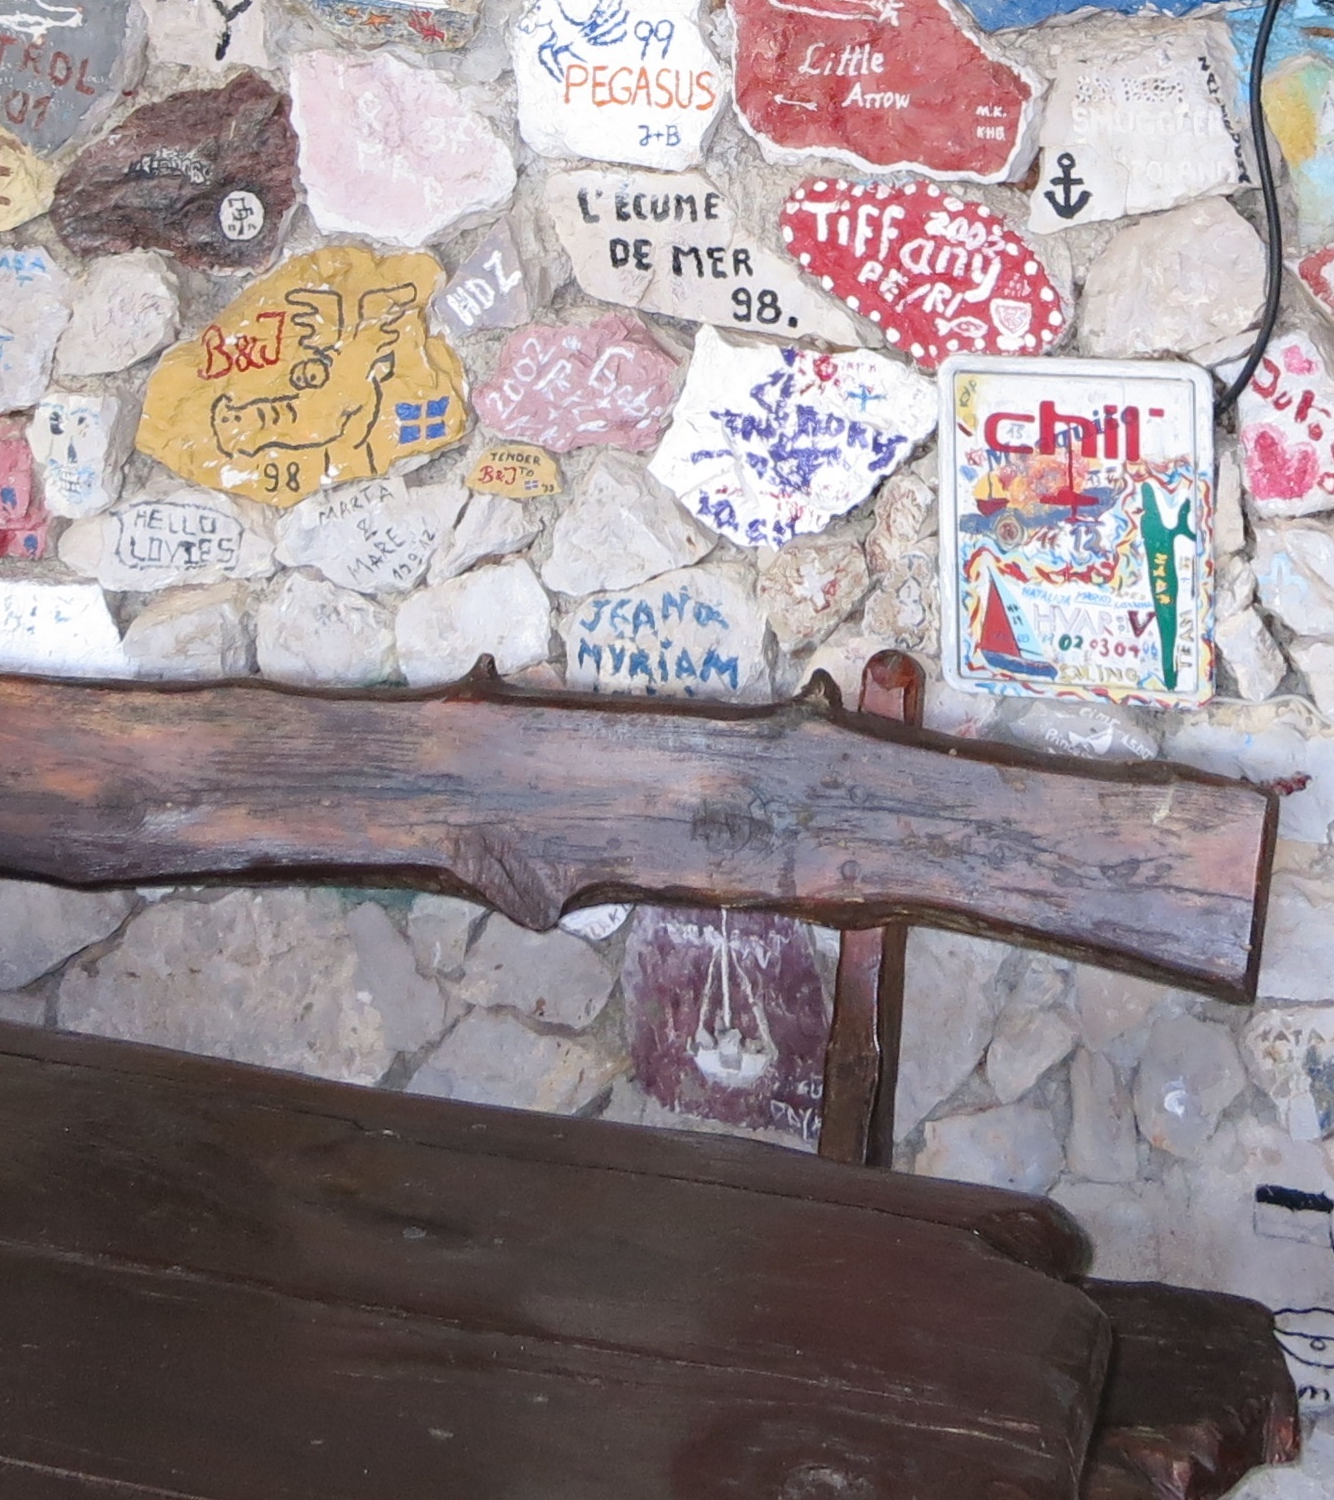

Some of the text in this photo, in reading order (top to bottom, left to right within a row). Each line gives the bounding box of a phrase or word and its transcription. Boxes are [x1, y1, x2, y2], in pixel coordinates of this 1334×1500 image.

[635, 18, 675, 60] 99
[562, 63, 718, 112] PEGASUS
[610, 237, 755, 281] DE MER
[196, 310, 287, 380] B&J
[133, 506, 219, 536] HELLO
[319, 483, 394, 525] MARTA
